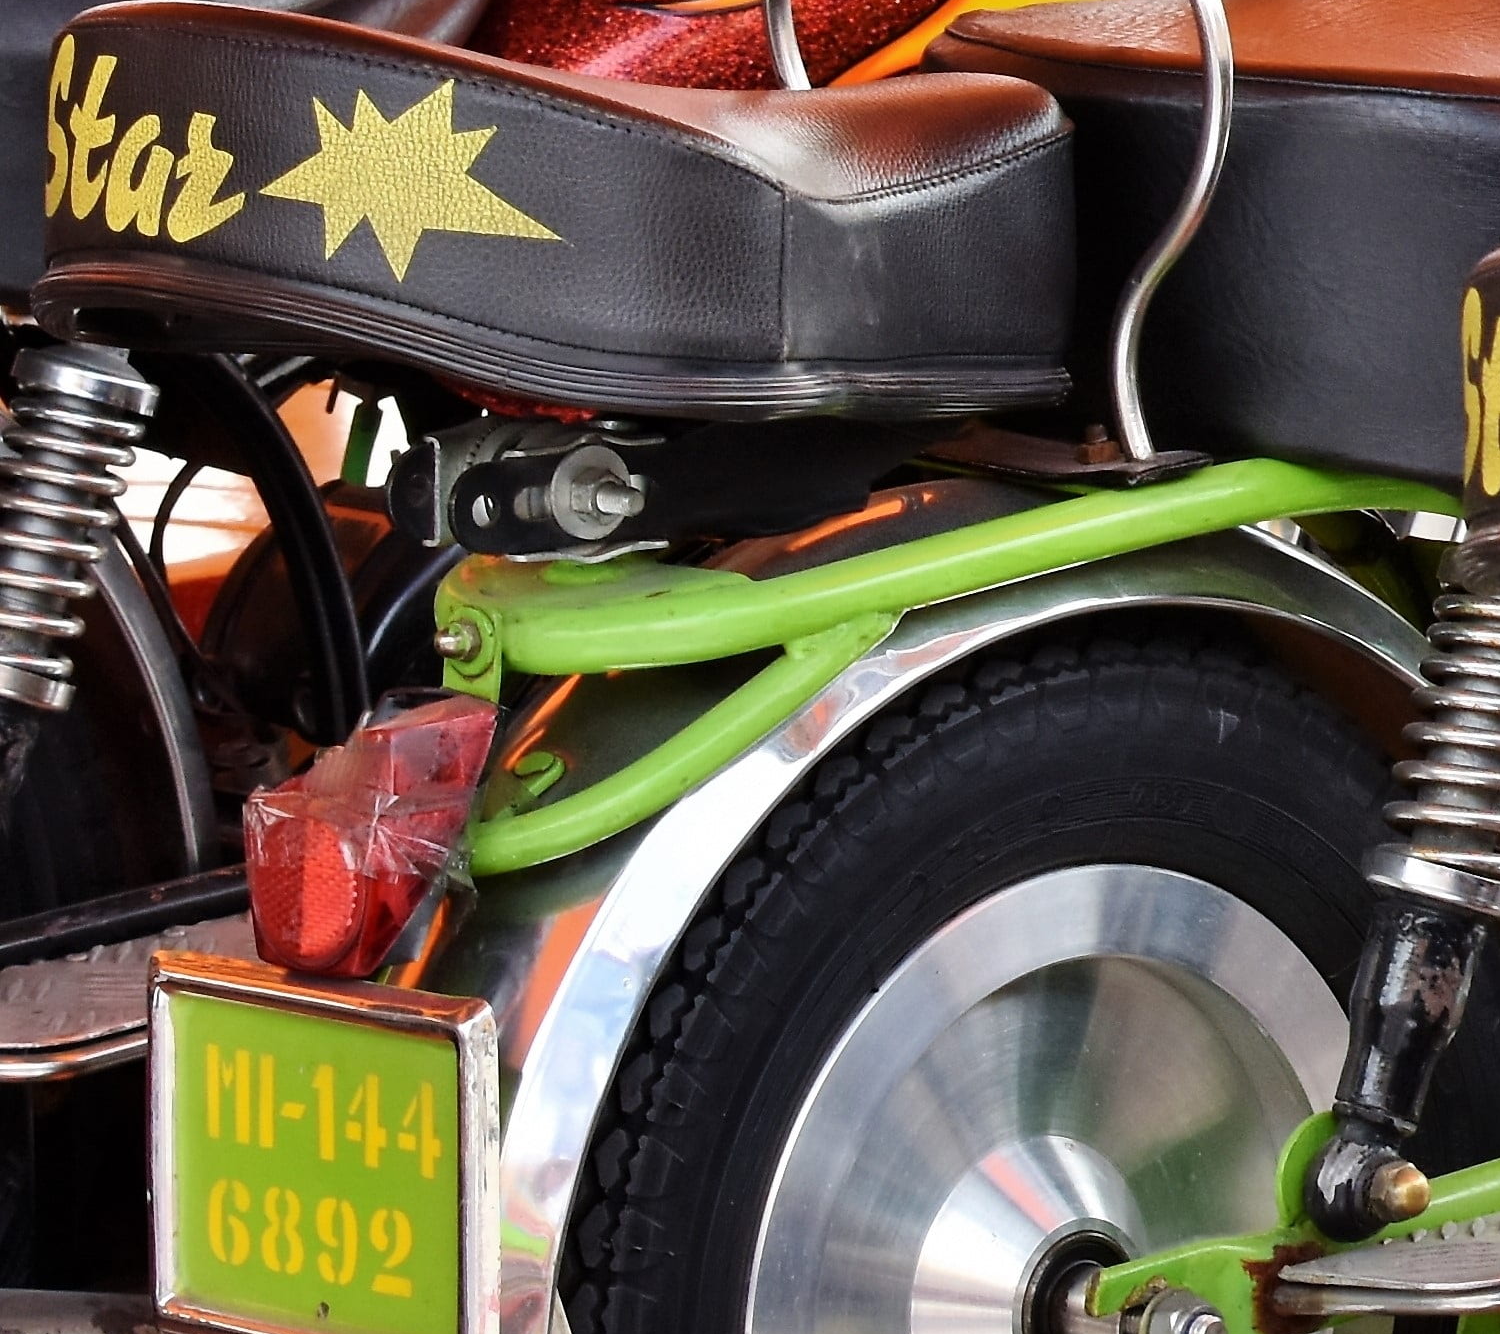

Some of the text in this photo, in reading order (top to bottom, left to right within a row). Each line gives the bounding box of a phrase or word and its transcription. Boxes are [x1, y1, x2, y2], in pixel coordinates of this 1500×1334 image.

[46, 33, 246, 243] Star
[206, 1043, 442, 1179] MI-144
[207, 1179, 414, 1298] 6892
